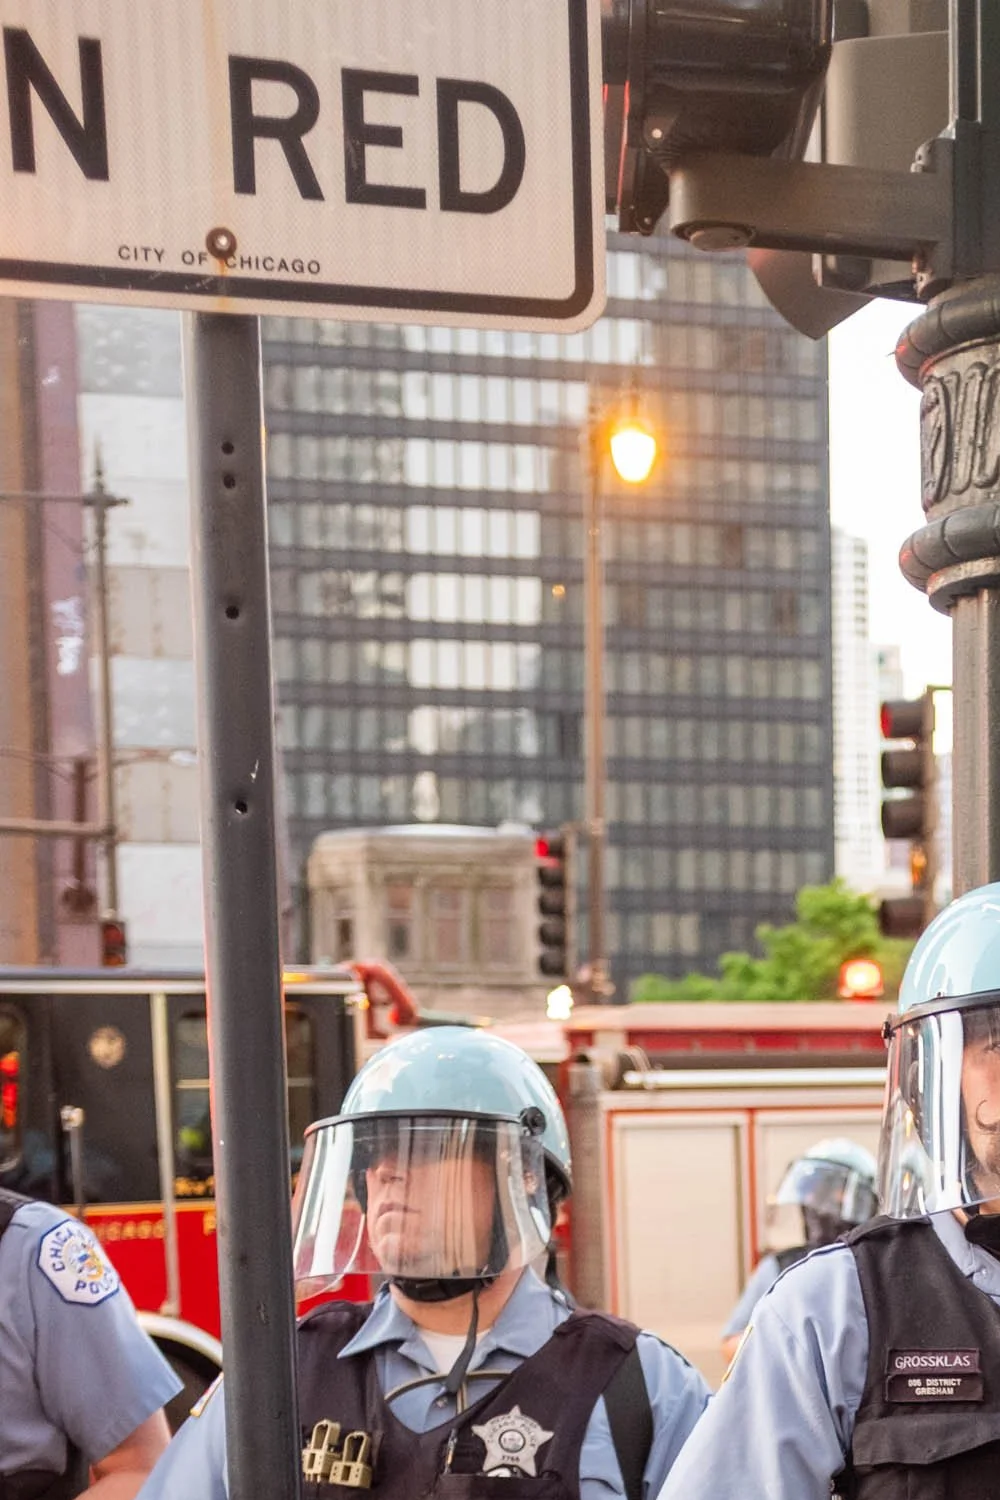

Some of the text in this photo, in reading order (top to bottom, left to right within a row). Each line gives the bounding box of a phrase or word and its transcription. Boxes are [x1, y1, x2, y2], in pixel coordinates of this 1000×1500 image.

[228, 54, 526, 214] RED
[117, 245, 321, 275] CITY OF CHICAGO
[894, 1355, 971, 1370] GROSSKLAS
[926, 1378, 962, 1388] DISTRICT
[914, 1387, 954, 1396] GRESHAM
